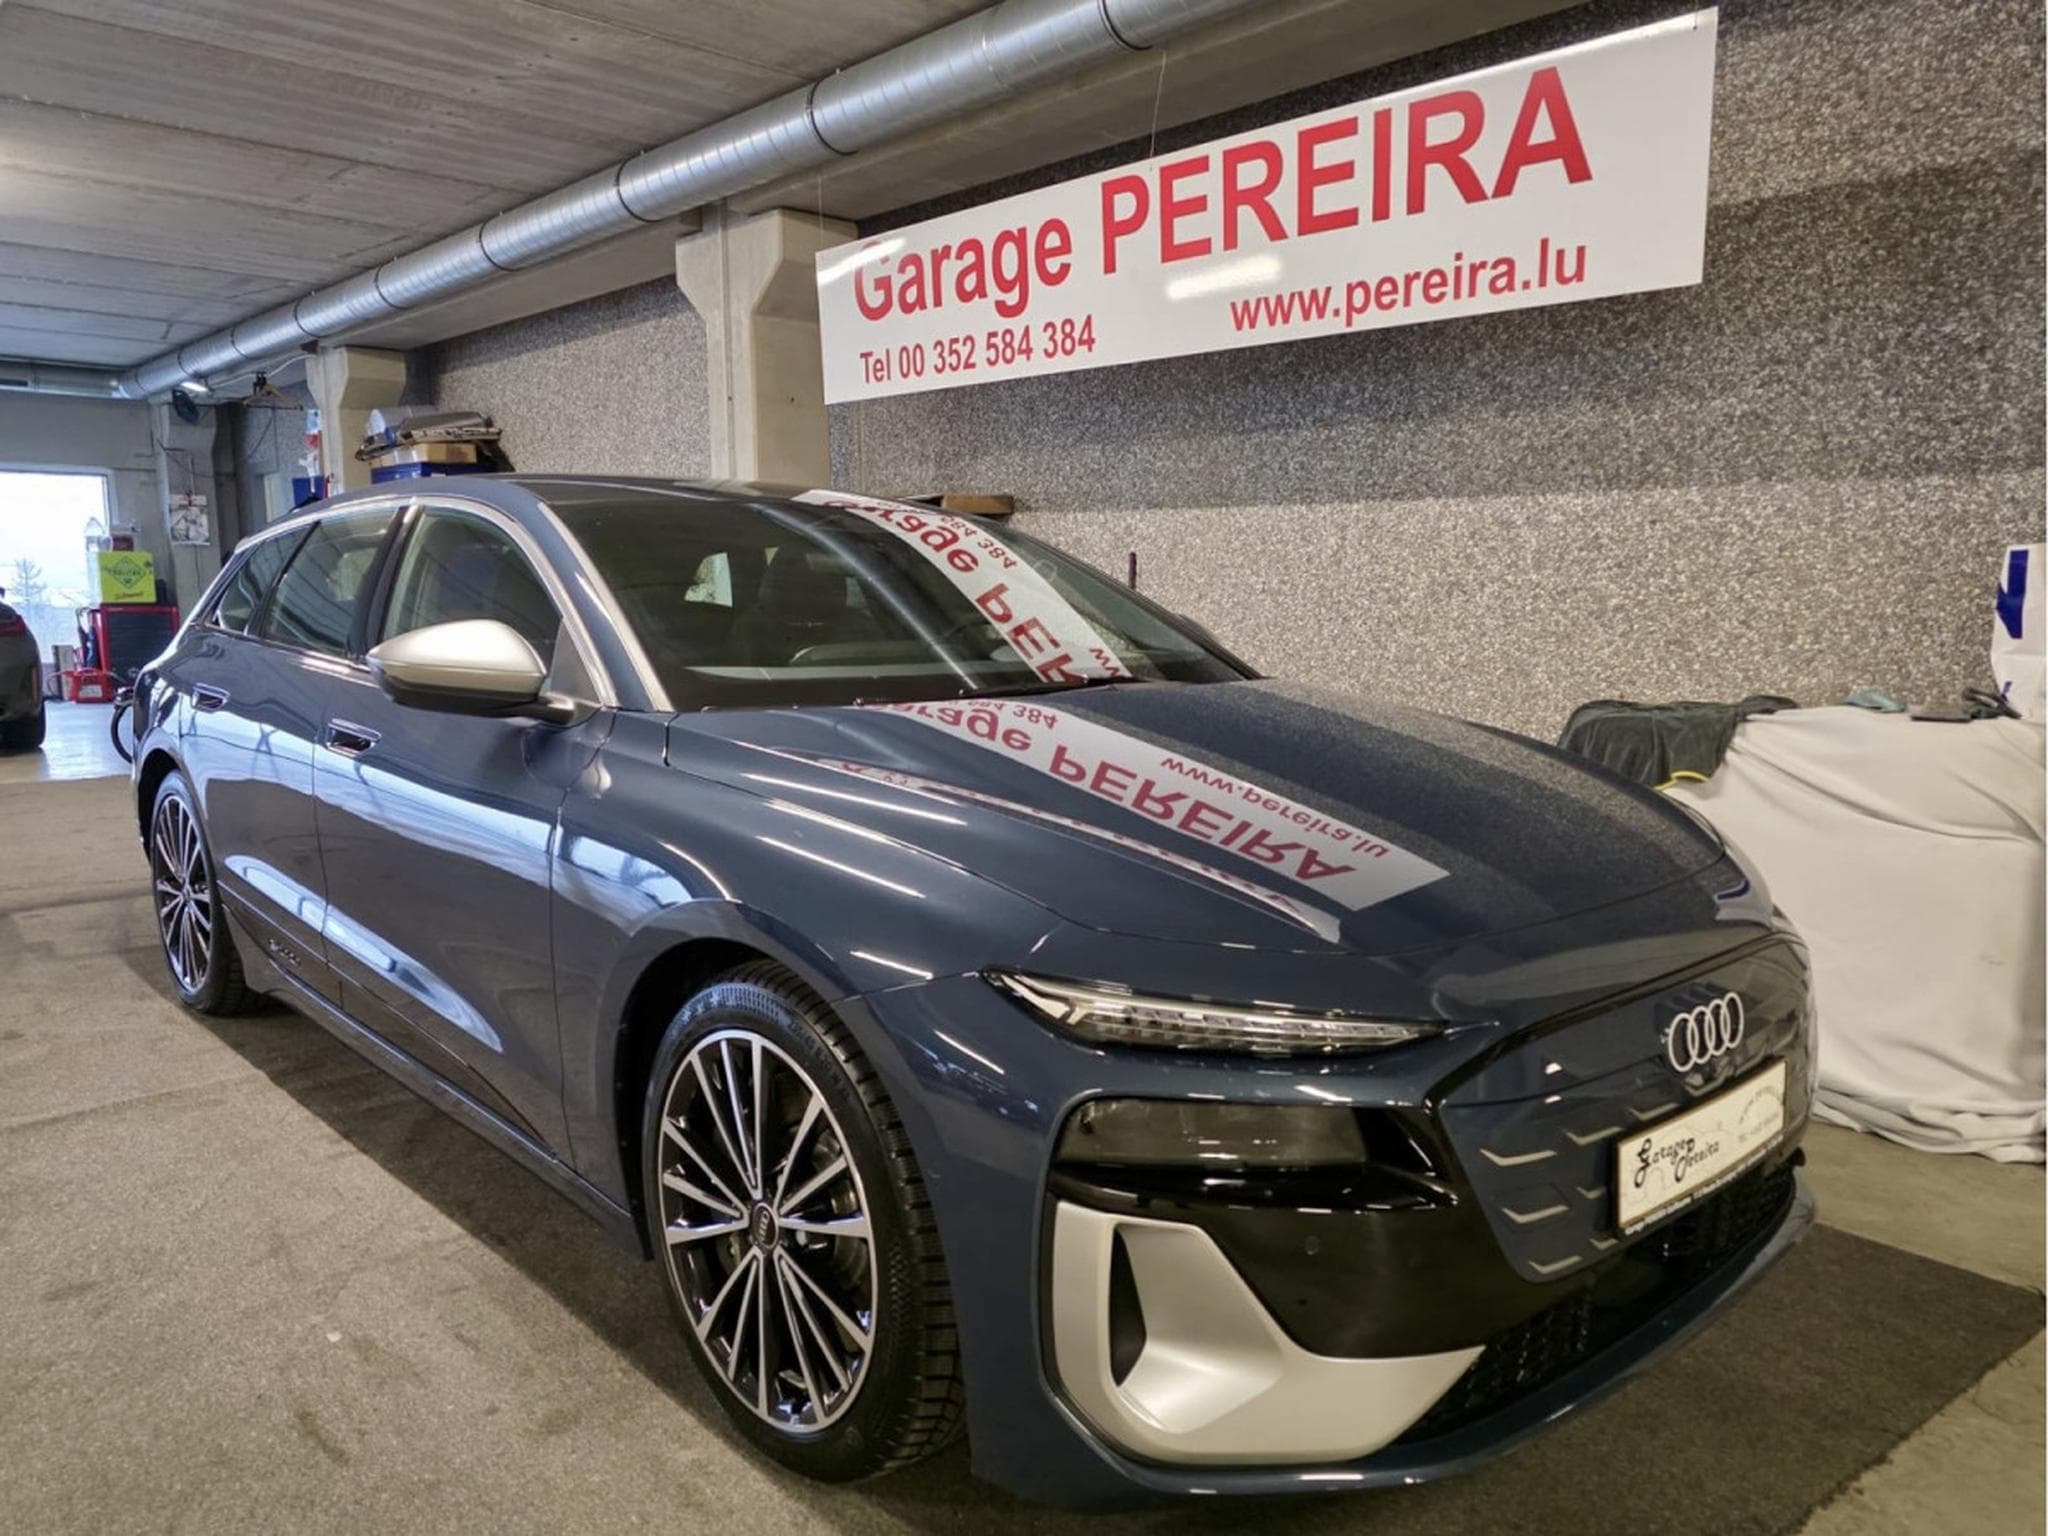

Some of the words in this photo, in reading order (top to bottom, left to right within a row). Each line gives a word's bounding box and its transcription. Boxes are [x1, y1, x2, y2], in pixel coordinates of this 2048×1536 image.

[854, 216, 1073, 321] Garage
[1101, 65, 1594, 276] PEREIRA
[1230, 236, 1588, 333] www.pereira.lu
[860, 350, 892, 384] Tel
[898, 343, 926, 379] 00
[933, 334, 977, 374] 352
[984, 325, 1034, 367] 584
[1042, 314, 1096, 361] 384
